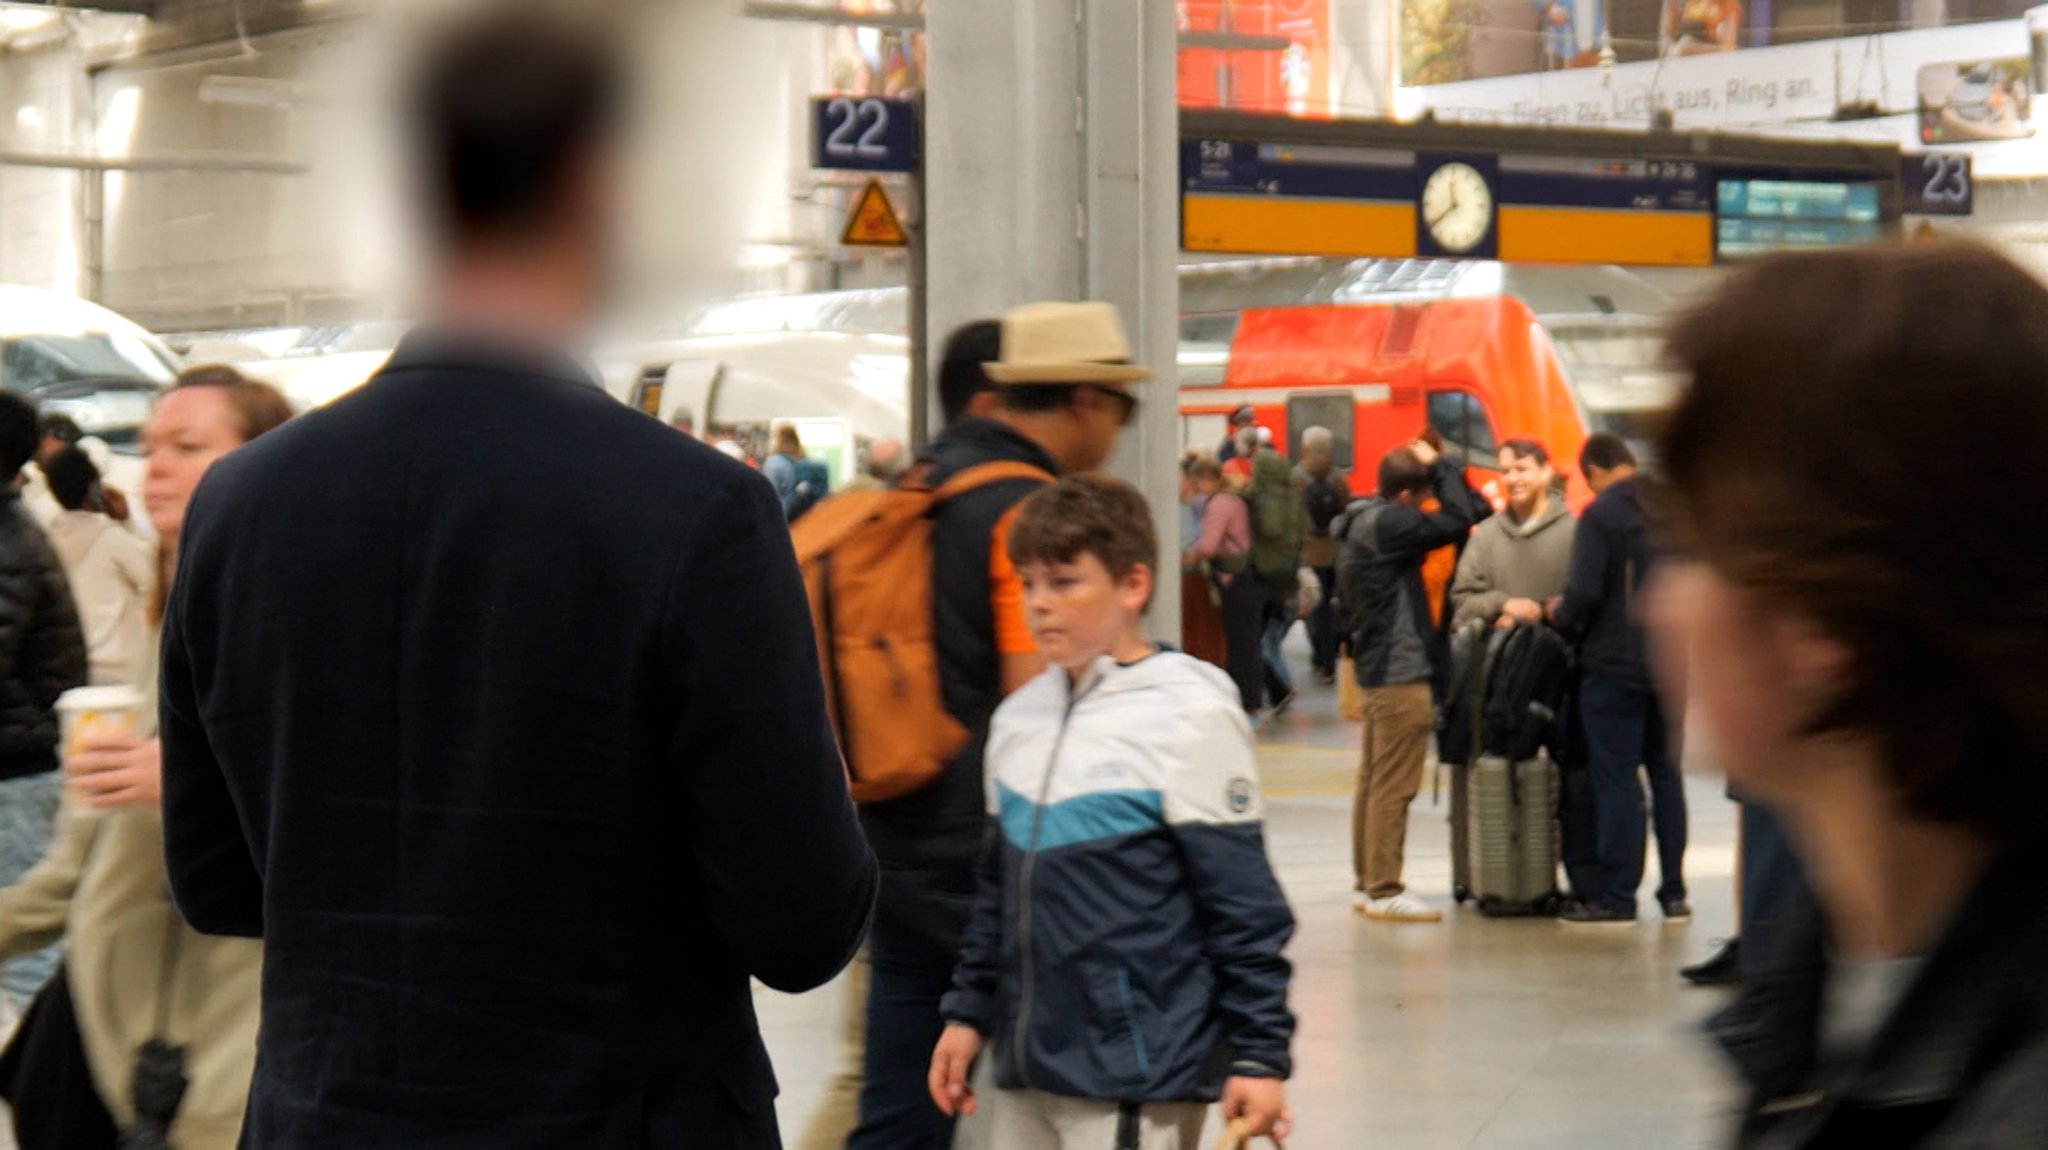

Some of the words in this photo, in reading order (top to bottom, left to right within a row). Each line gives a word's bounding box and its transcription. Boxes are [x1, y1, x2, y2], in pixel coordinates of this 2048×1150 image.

[1673, 88, 1719, 111] aus,
[1726, 78, 1777, 107] Ring
[826, 97, 888, 152] 22
[1922, 155, 1968, 200] 23
